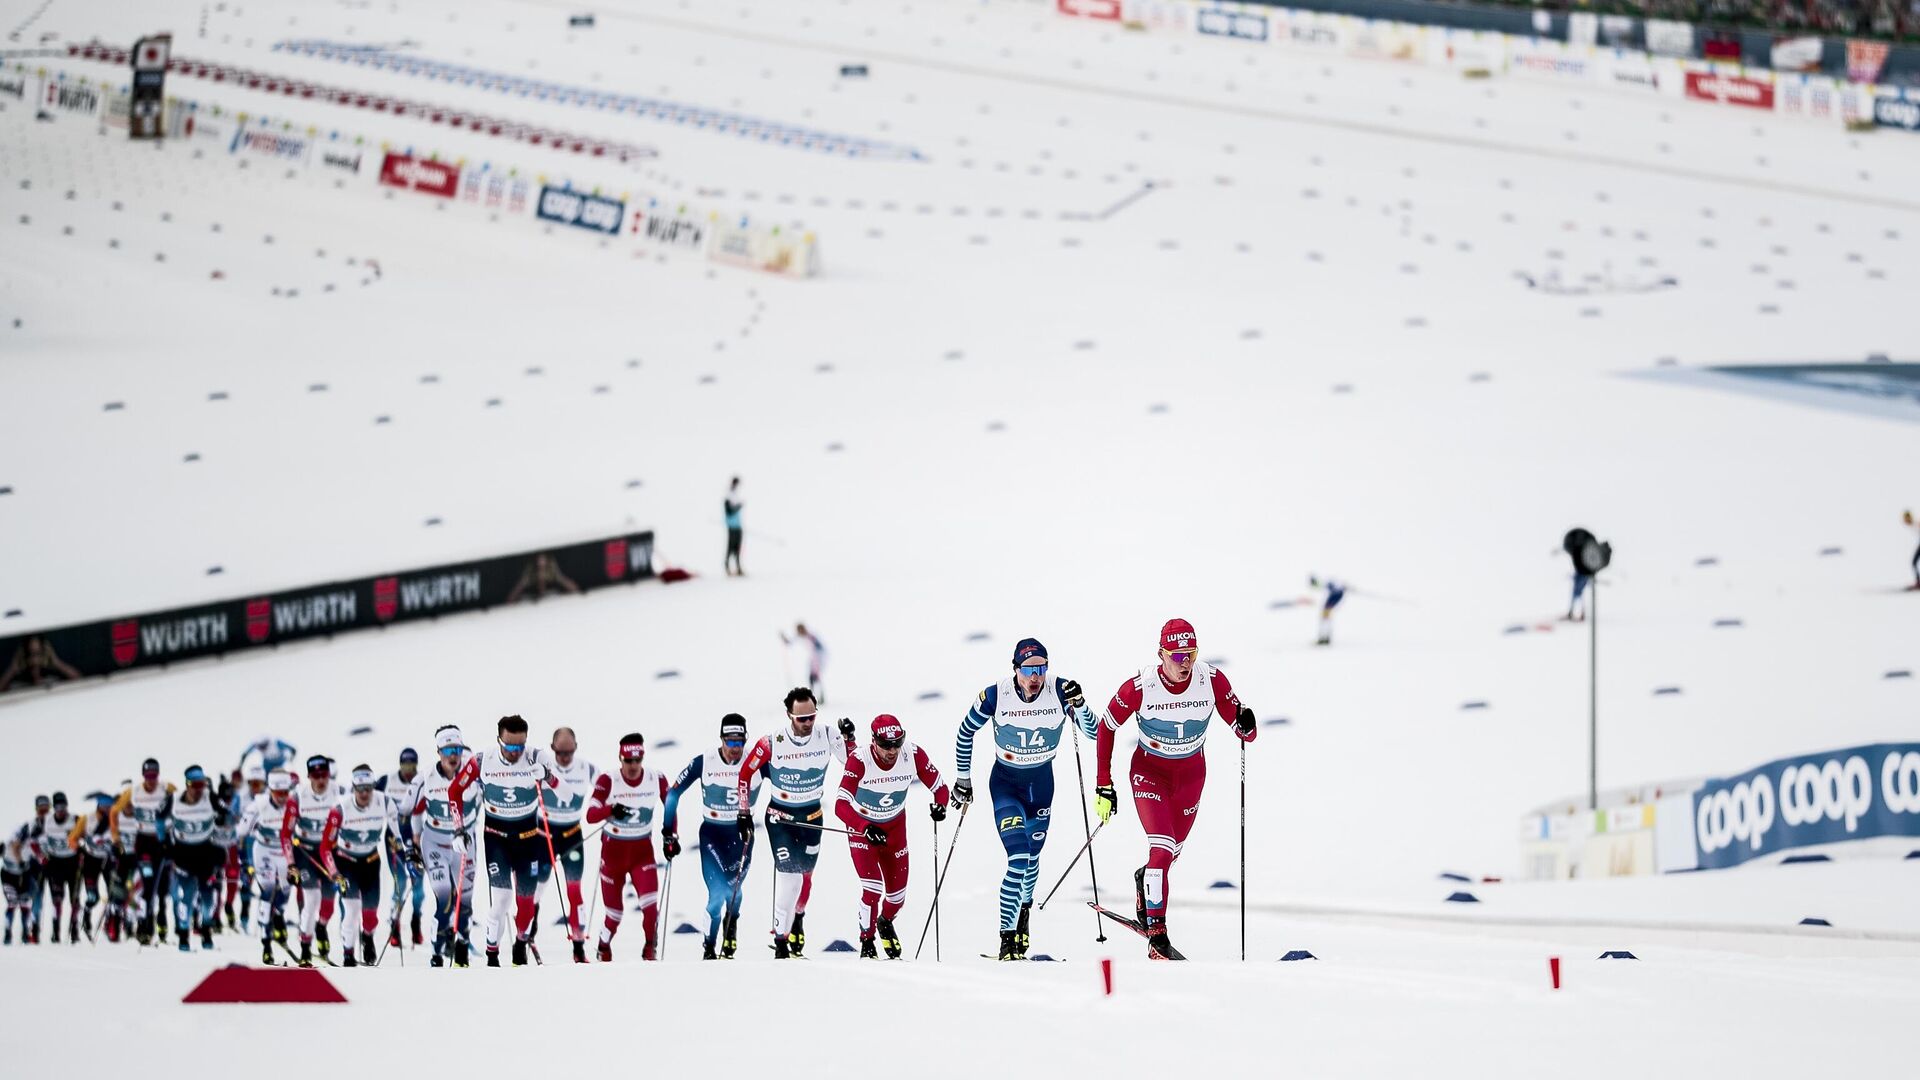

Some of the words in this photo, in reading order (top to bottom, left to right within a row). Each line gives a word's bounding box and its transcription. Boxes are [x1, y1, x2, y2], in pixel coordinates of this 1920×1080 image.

[1155, 700, 1209, 711] INTERSPORT
[1008, 708, 1058, 718] INTERSPORT
[1174, 724, 1184, 739] 1
[1016, 730, 1045, 748] 14
[1150, 733, 1198, 744] OBERSTDORF
[783, 750, 826, 760] INTERSPORT
[1005, 744, 1050, 754] OBERSTDORF
[869, 774, 913, 785] INTERSPORT
[502, 789, 517, 803] 3
[725, 789, 738, 805] 5
[879, 794, 894, 807] 6
[1134, 790, 1162, 802] LUKOIL
[1697, 773, 1775, 853] coop
[1779, 755, 1872, 833] coop
[1000, 816, 1023, 829] FF
